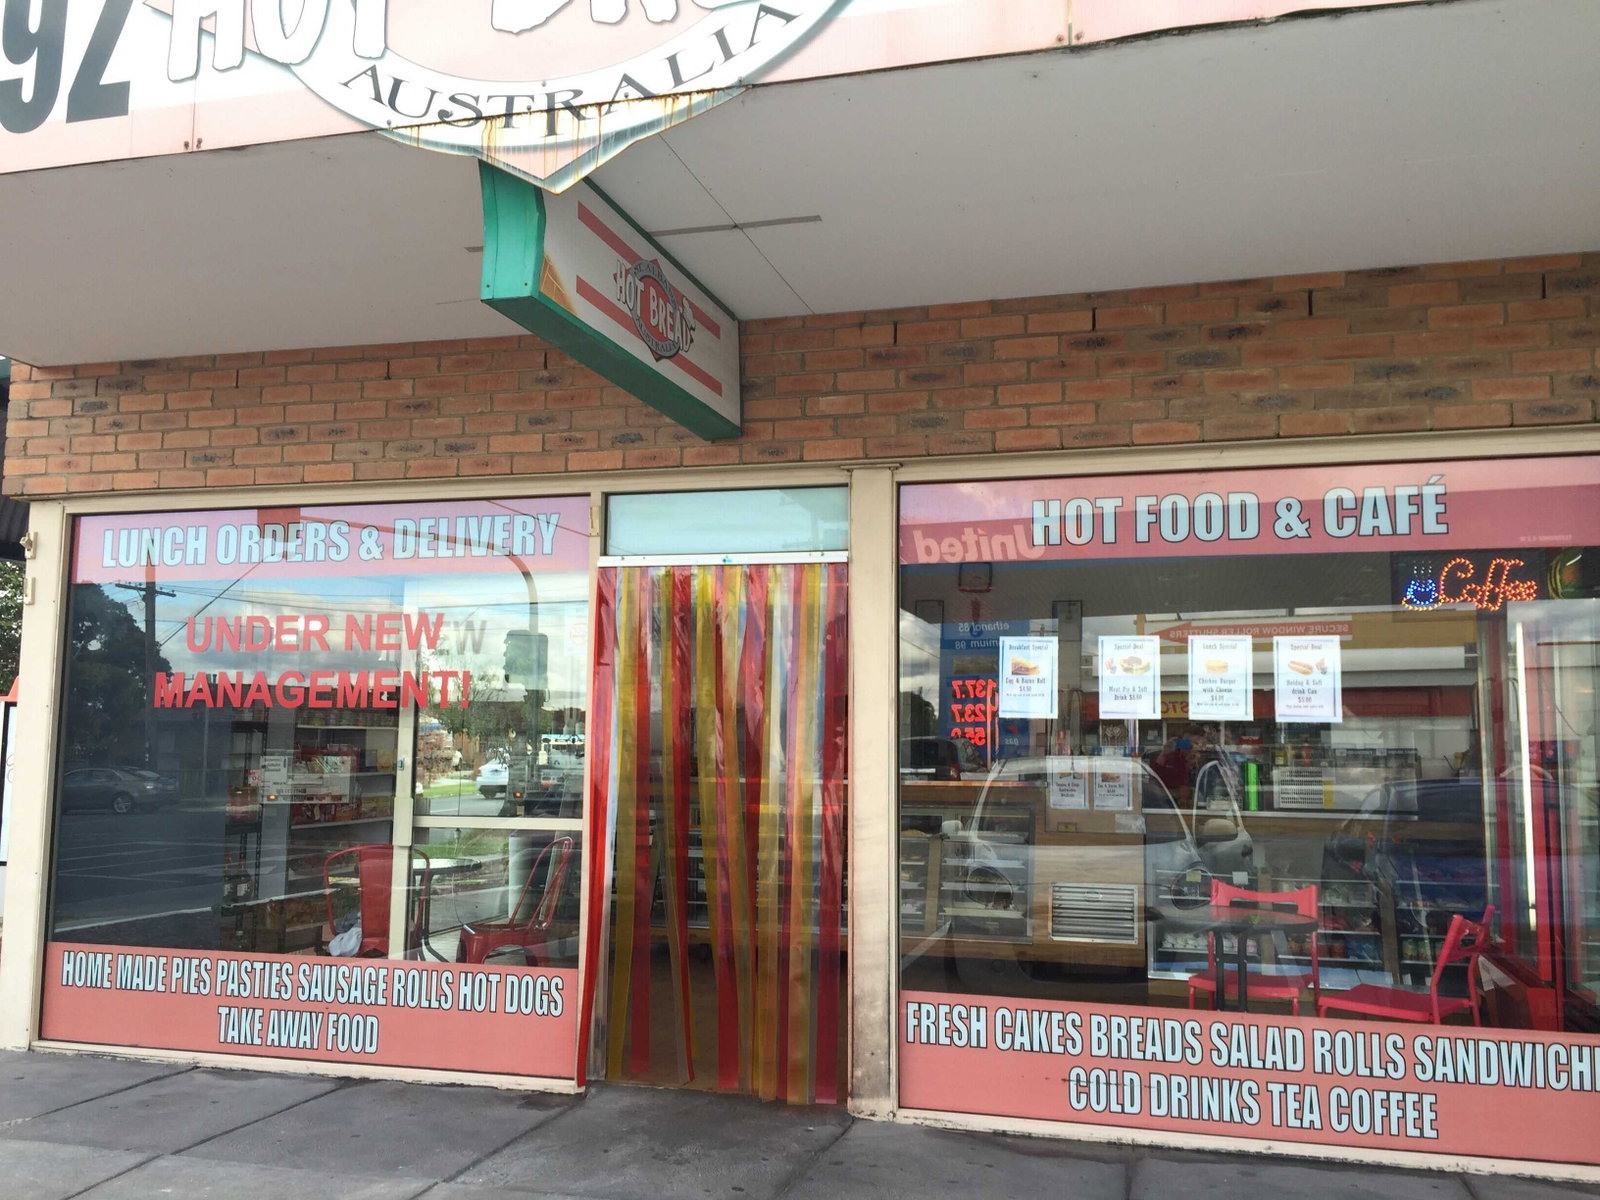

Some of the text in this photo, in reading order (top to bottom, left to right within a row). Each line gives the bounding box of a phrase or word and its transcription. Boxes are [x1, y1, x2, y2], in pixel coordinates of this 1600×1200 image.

[340, 3, 801, 137] AUSTRALIA
[616, 259, 645, 318] HOT
[101, 512, 561, 569] LUNCH ORDERS & DELIVERY
[1030, 474, 1449, 547] HOT FOOD & CAFÉ
[186, 612, 444, 653] UNDER NEW
[154, 671, 472, 710] MANAGEMENT!
[61, 951, 564, 1017] HOME MADE PIES PASTIES SAUSAGE ROLLS HOT DOGS
[218, 1005, 379, 1054] TAKE AWAY FOOD
[905, 1002, 987, 1049] FRESH
[994, 1006, 1084, 1057] CAKES
[1090, 1014, 1204, 1067] BREADS
[1210, 1021, 1305, 1074] SALAD
[1314, 1028, 1407, 1081] ROLLS
[1067, 1066, 1439, 1141] COLD DRINKS TEA COFFEE
